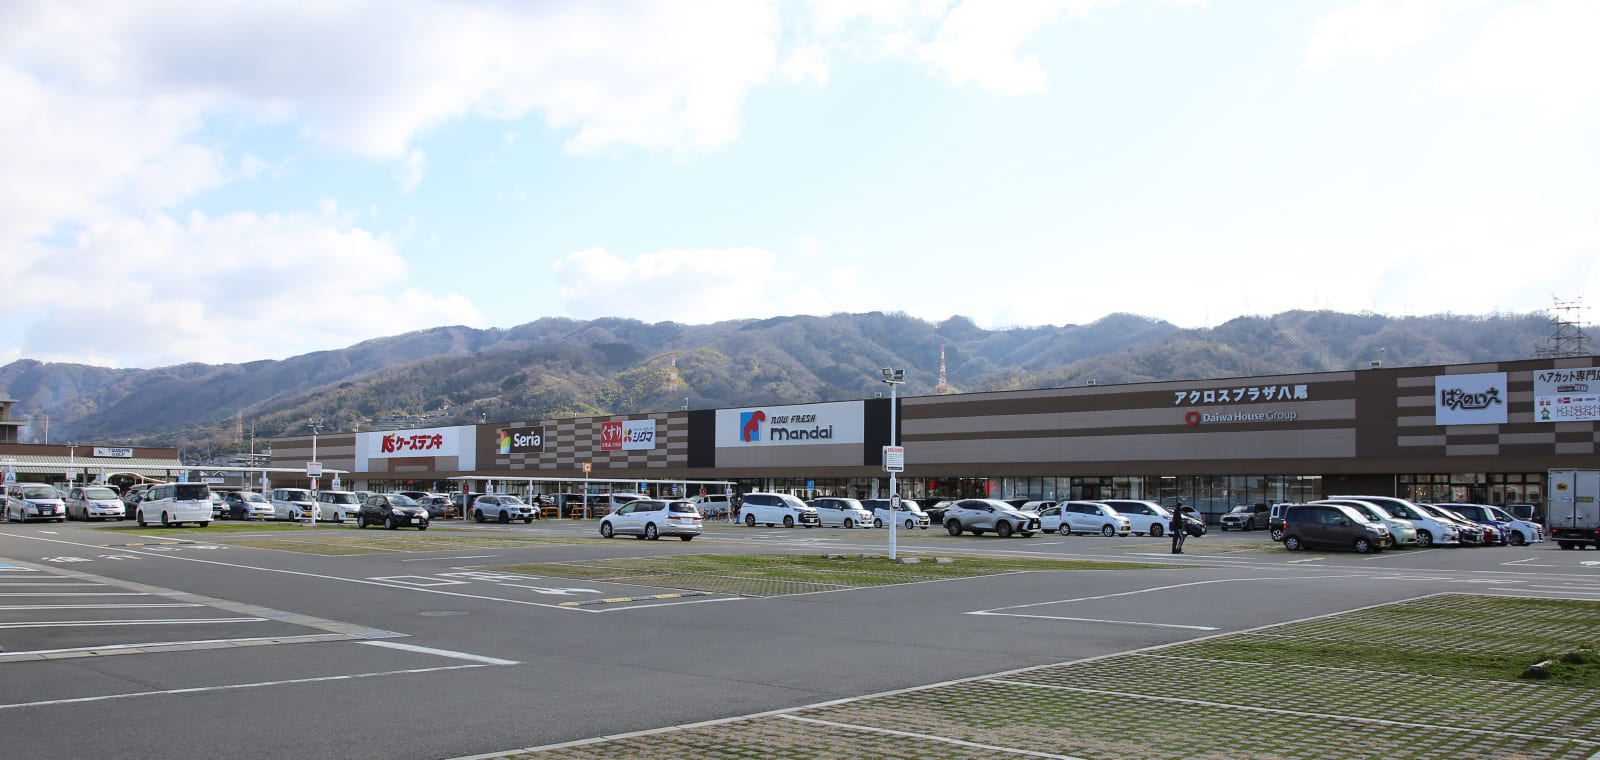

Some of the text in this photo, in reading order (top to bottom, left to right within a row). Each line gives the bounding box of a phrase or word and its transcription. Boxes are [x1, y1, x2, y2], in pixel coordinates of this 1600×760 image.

[1174, 385, 1308, 405] アクロスプラザ八尾
[790, 414, 816, 423] FRESH
[1202, 410, 1297, 422] Daiwa House Group
[513, 430, 541, 447] Seria
[602, 425, 622, 441] くすり
[632, 431, 653, 442] シグマ
[770, 425, 832, 441] mandai
[584, 463, 592, 471] C
